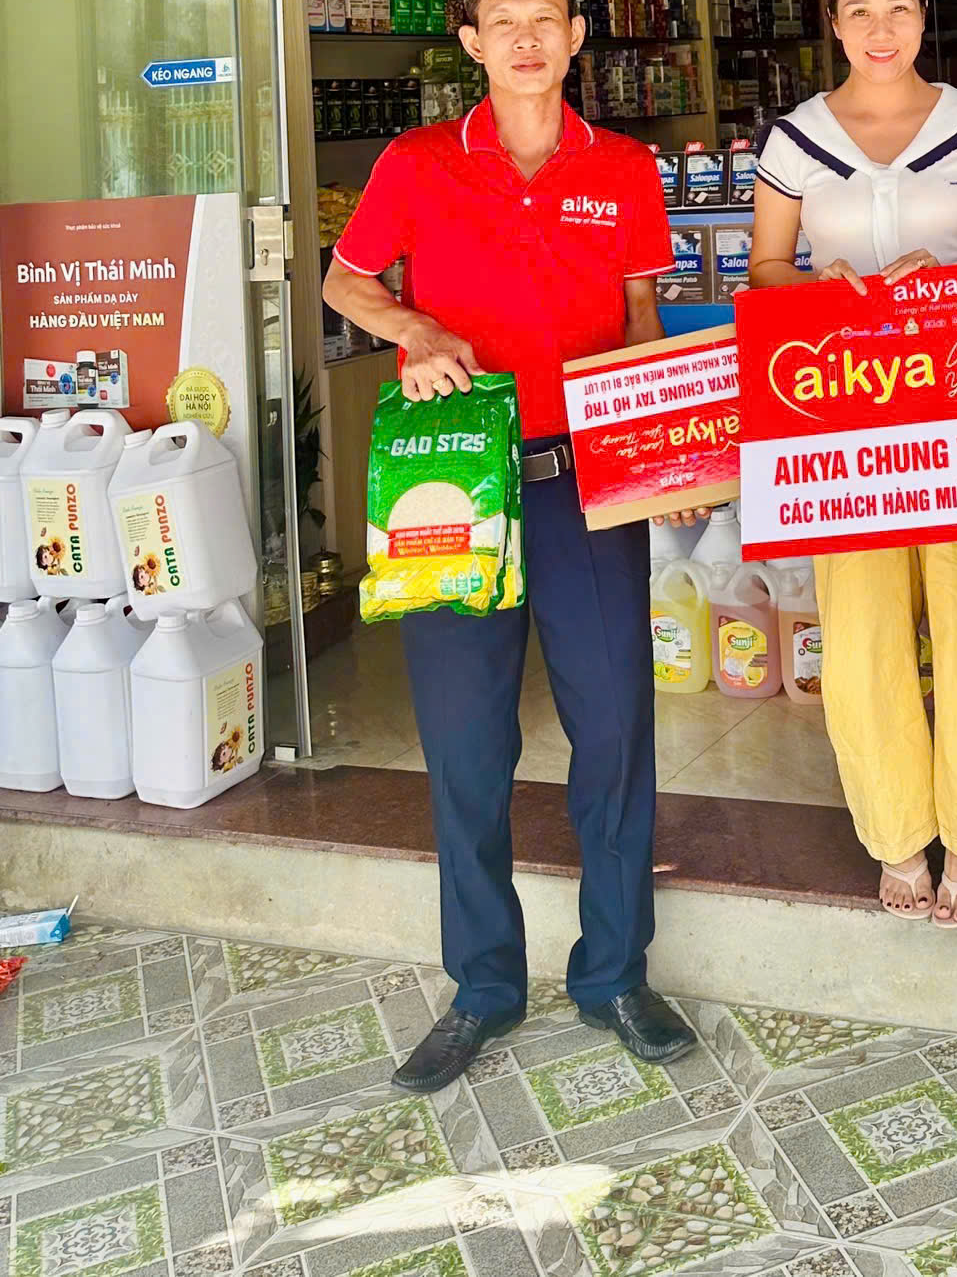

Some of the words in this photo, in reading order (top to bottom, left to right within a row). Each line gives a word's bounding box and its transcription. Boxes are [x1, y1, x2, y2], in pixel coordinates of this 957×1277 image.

[151, 67, 171, 81] KÉO
[174, 66, 213, 80] NGANG
[690, 173, 720, 184] Salonpas
[561, 195, 618, 218] aikya
[17, 261, 57, 283] Bình
[60, 261, 81, 287] Vị
[84, 259, 124, 281] Thái
[129, 257, 176, 280] Minh
[675, 258, 698, 272] npas
[721, 257, 749, 268] Salon
[53, 292, 73, 304] SẢN
[74, 291, 102, 304] PHẨM
[104, 293, 118, 305] DẠ
[119, 290, 138, 303] DÀY
[30, 311, 67, 328] HÀNG
[69, 310, 97, 327] ĐẦU
[99, 310, 130, 329] VIỆT
[133, 313, 165, 326] NAM
[895, 306, 919, 315] Energy
[793, 349, 936, 404] aikya
[635, 389, 657, 409] TAY
[661, 379, 705, 403] CHUNG
[584, 399, 610, 421] TRỢ
[669, 415, 741, 447] aikya
[391, 435, 433, 458] GẠO
[436, 432, 487, 452] ST25
[774, 450, 849, 486] AIKYA
[856, 439, 950, 477] CHUNG
[66, 483, 79, 531] PUNZO
[779, 497, 814, 525] CÁC
[819, 492, 877, 521] KHÁCH
[883, 487, 930, 515] HÀNG
[155, 494, 172, 544] PUNZO
[70, 535, 83, 573] CATA
[164, 547, 181, 587] CATA
[656, 626, 678, 639] Sunji
[730, 635, 753, 649] Sunji
[806, 638, 823, 650] Sun
